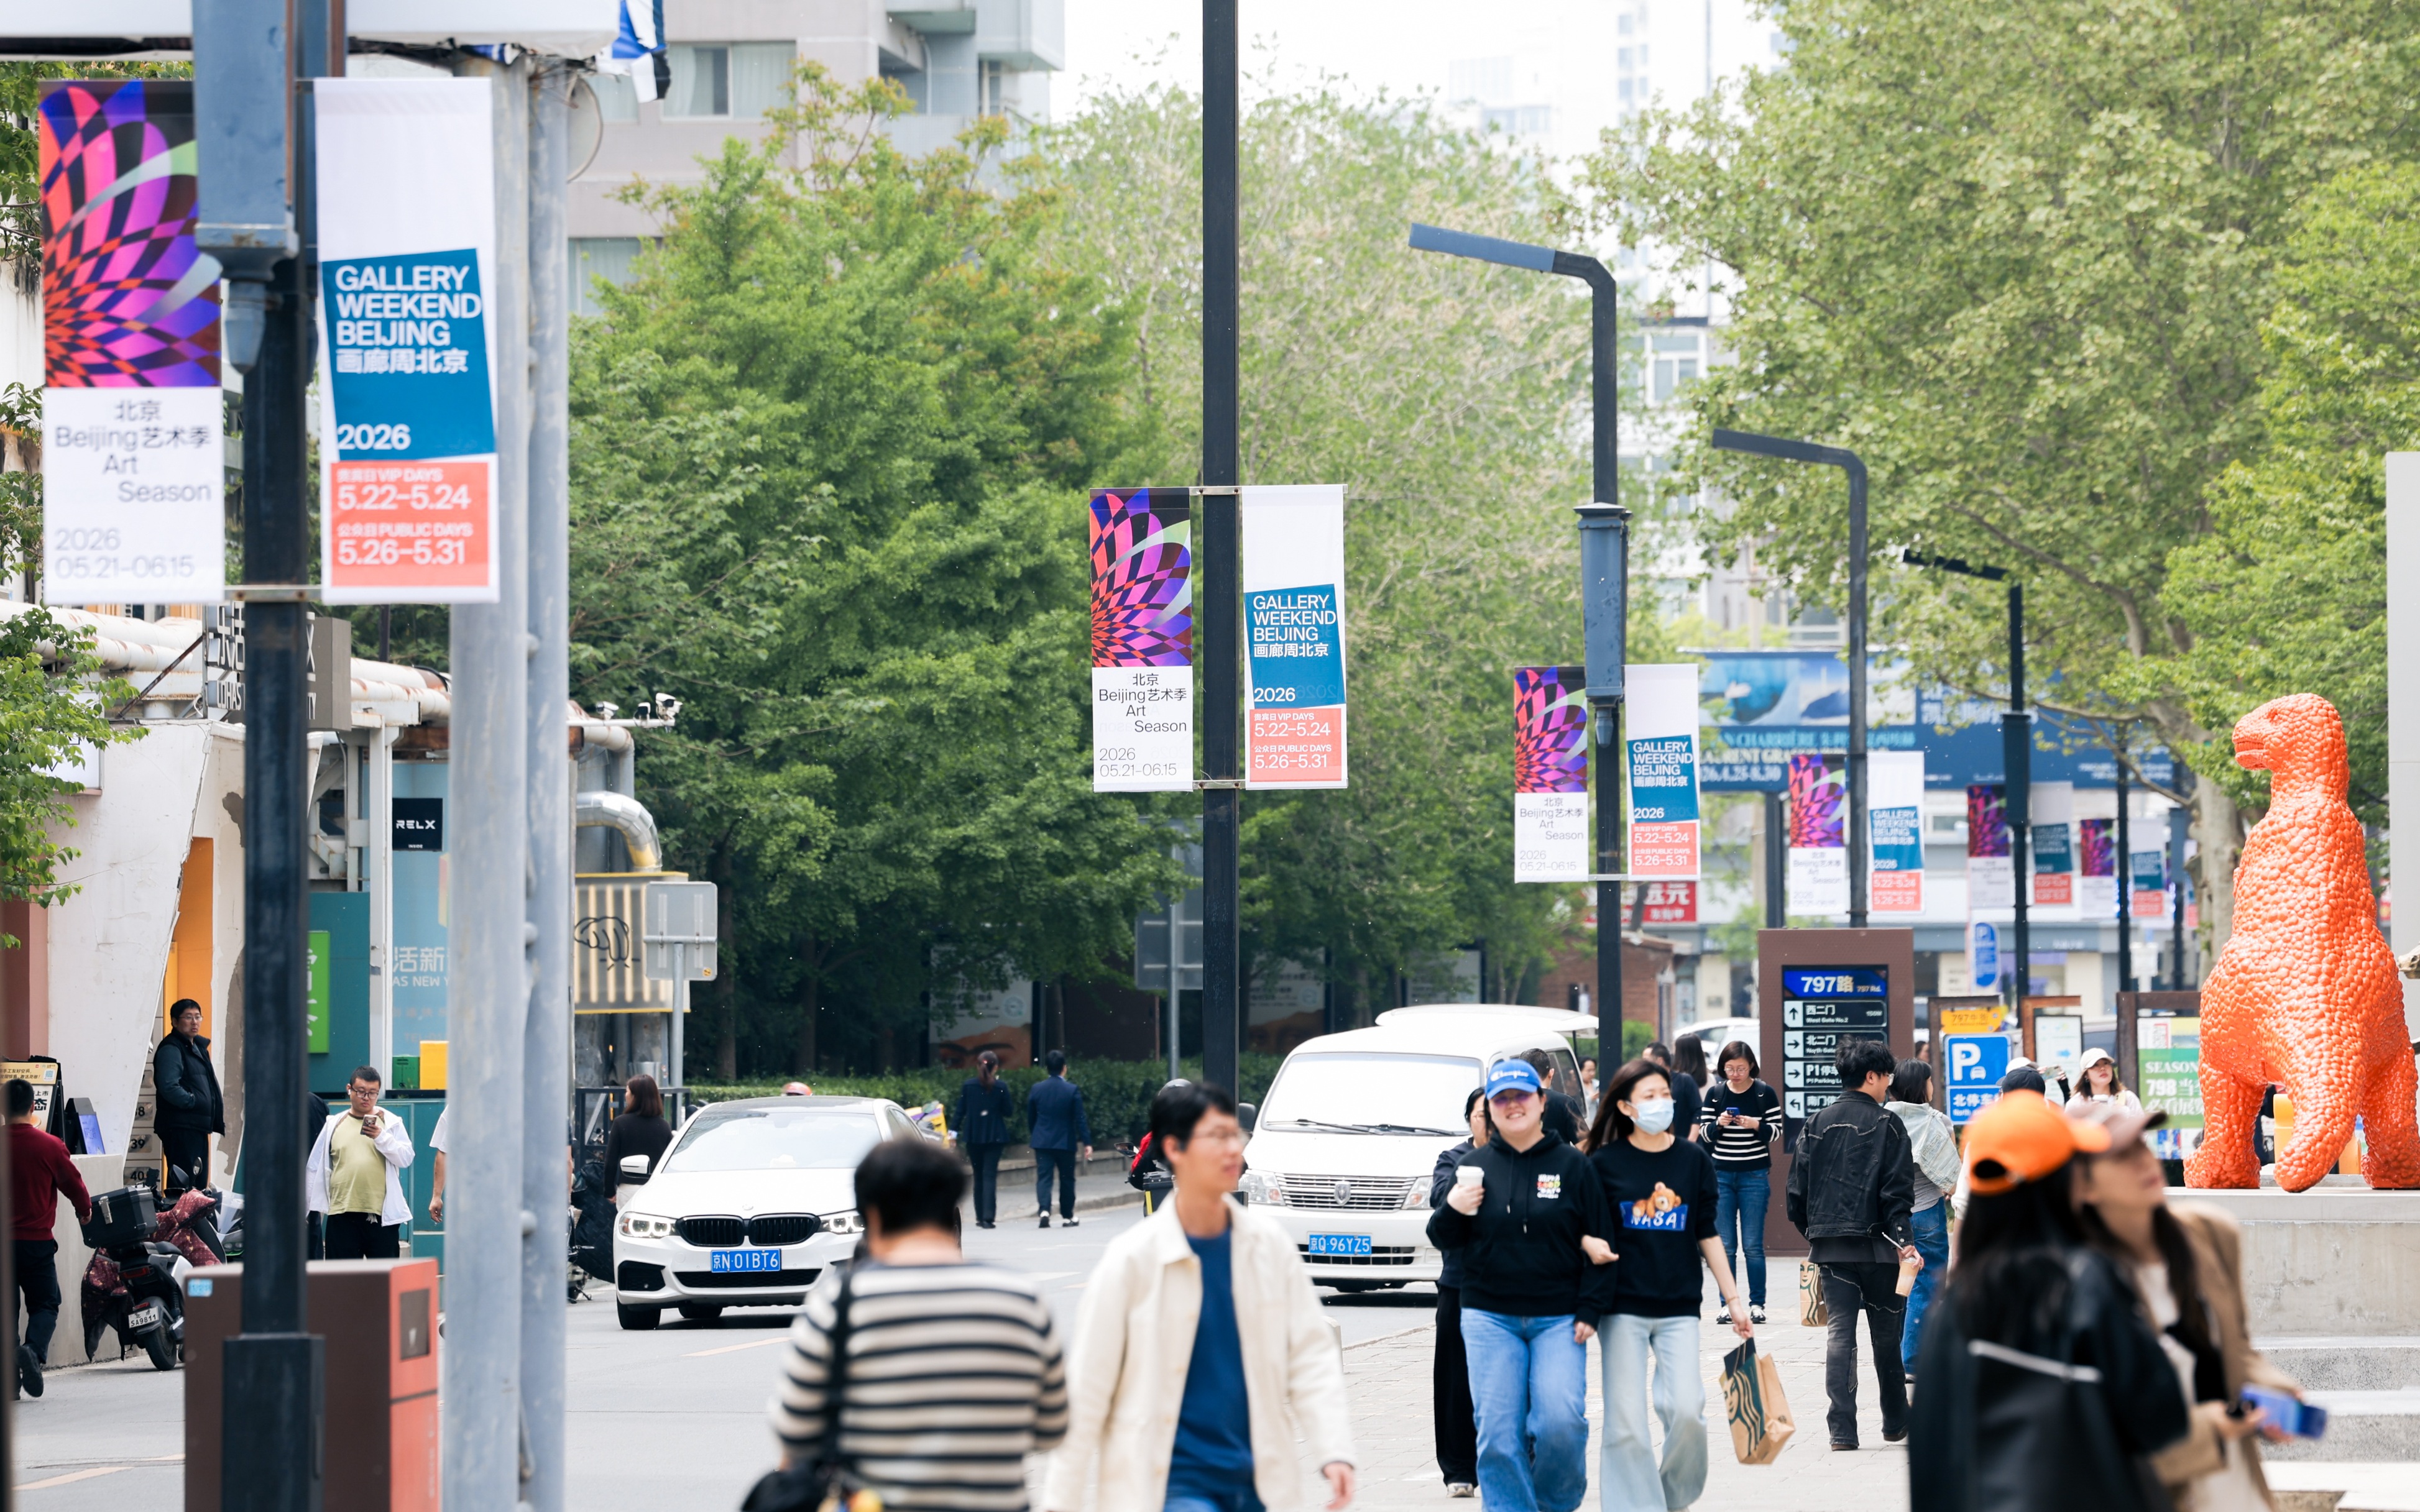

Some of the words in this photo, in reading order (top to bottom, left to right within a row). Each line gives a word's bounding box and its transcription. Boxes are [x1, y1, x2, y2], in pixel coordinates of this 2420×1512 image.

[335, 265, 469, 291] GALLERY
[336, 293, 482, 318] WEEKEND
[336, 321, 450, 346] BEIJING
[336, 348, 469, 374] 画廊周北京
[115, 400, 162, 421] 北京
[337, 424, 411, 450] 2026
[103, 454, 137, 474] Art
[377, 469, 402, 482] VIP
[403, 468, 444, 482] DAYS
[118, 482, 211, 502] Season
[379, 523, 431, 536] PUBLIC
[433, 523, 473, 536] DAYS
[55, 528, 121, 551] 2026
[1253, 595, 1330, 610] GALLERY
[1254, 610, 1336, 625] WEEKEND
[1254, 627, 1318, 642] BEIJING
[1253, 643, 1329, 657] 画廊周北京
[1133, 673, 1159, 686] 北京
[1254, 687, 1295, 702] 2026
[1126, 705, 1146, 717] Art
[1134, 720, 1187, 733] Season
[1278, 745, 1309, 753] PUBLIC
[1633, 741, 1688, 753] GALLERY
[1100, 748, 1136, 761] 2026
[1633, 753, 1693, 764] WEEKEND
[1634, 764, 1680, 776] BEIJING
[1634, 776, 1688, 787] 画廊周北京
[1544, 797, 1563, 807] 北京
[1634, 807, 1665, 819] 2026
[1873, 810, 1916, 819] GALLERY
[395, 820, 436, 830] RELX
[1539, 820, 1554, 828] Art
[1873, 819, 1918, 828] WEEKEND
[1545, 831, 1584, 840] Season
[1874, 828, 1910, 836] BEIJING
[1520, 850, 1547, 860] 2026
[413, 976, 440, 987] NEW
[1805, 1005, 1835, 1015] 西二门
[1806, 1035, 1836, 1046] 北二门
[1951, 1043, 1981, 1081] P
[1953, 1093, 2000, 1107] 北停车
[131, 1139, 145, 1149] 39
[130, 1171, 144, 1181] 40
[1631, 1211, 1677, 1229] NASA
[131, 1314, 157, 1327] SA9811
